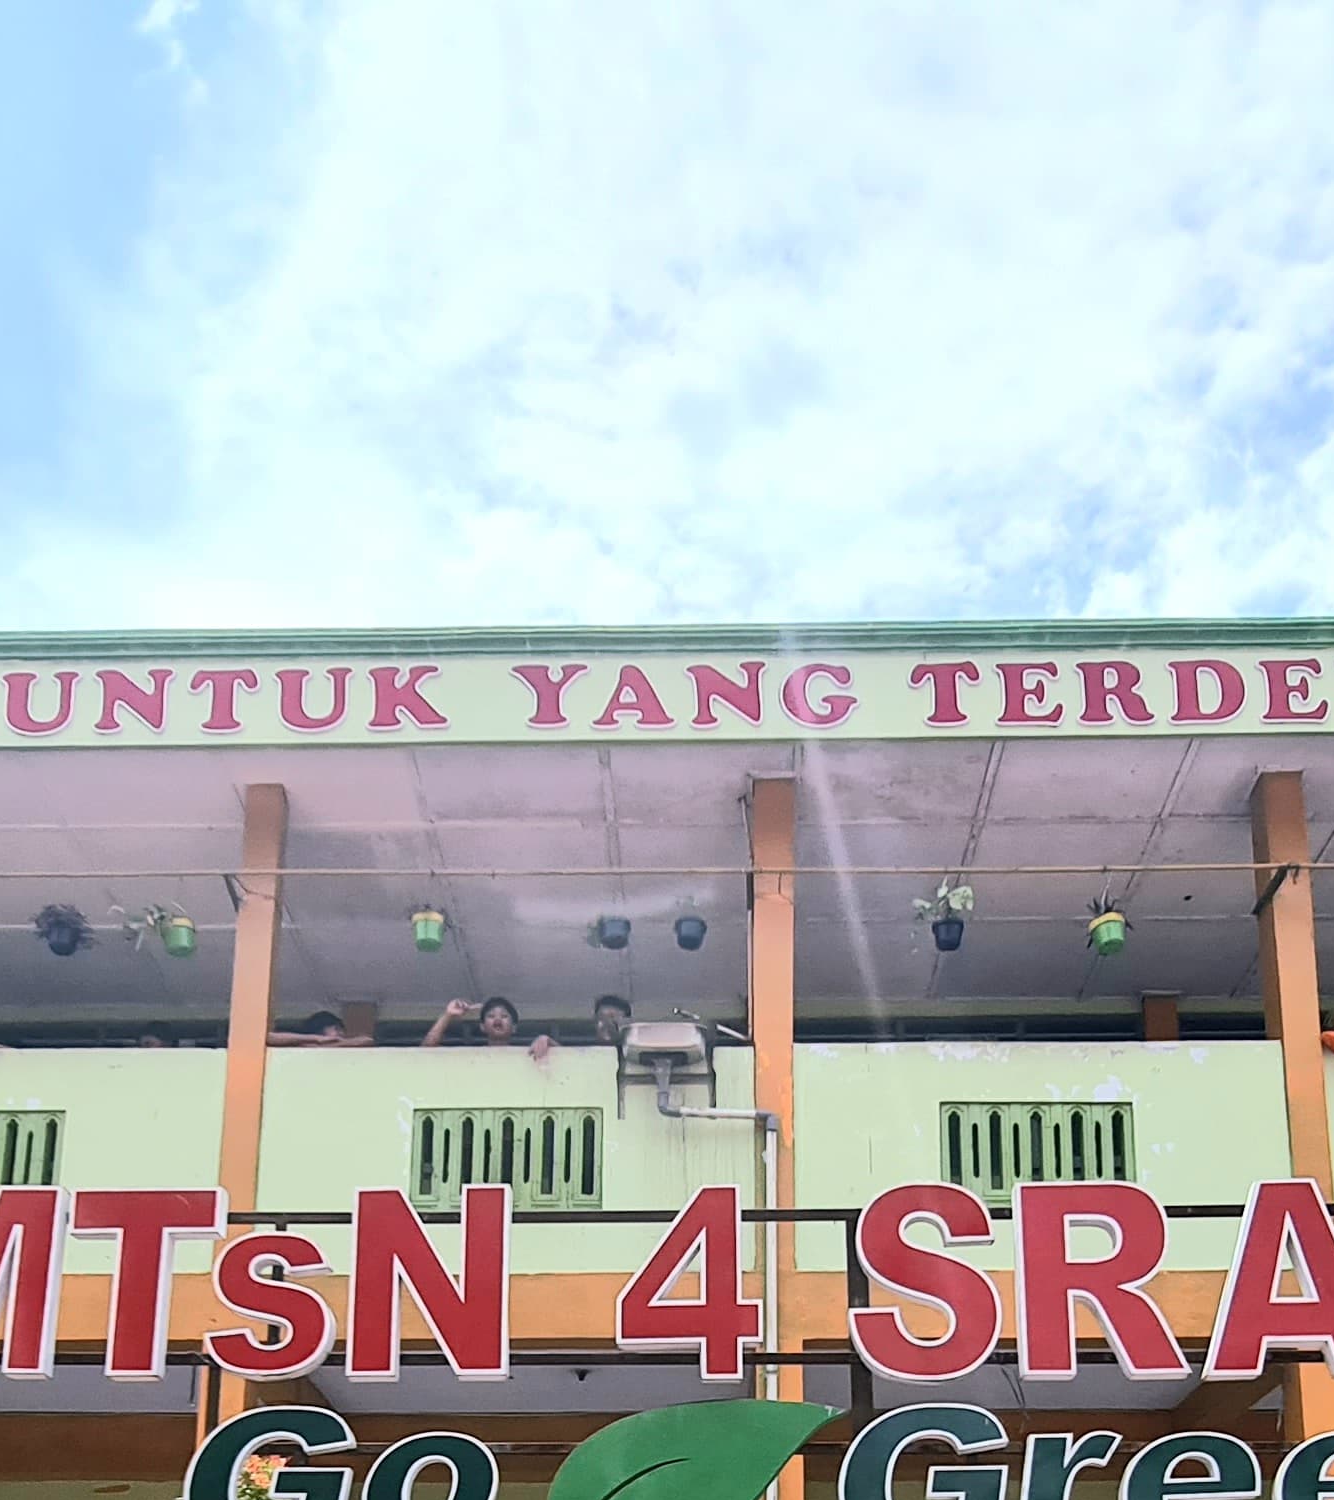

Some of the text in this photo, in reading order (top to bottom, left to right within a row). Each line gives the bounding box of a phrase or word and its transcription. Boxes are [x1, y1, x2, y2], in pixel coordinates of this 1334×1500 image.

[2, 666, 450, 736] UNTUK
[511, 661, 858, 729] YANG
[615, 1184, 765, 1381] 4
